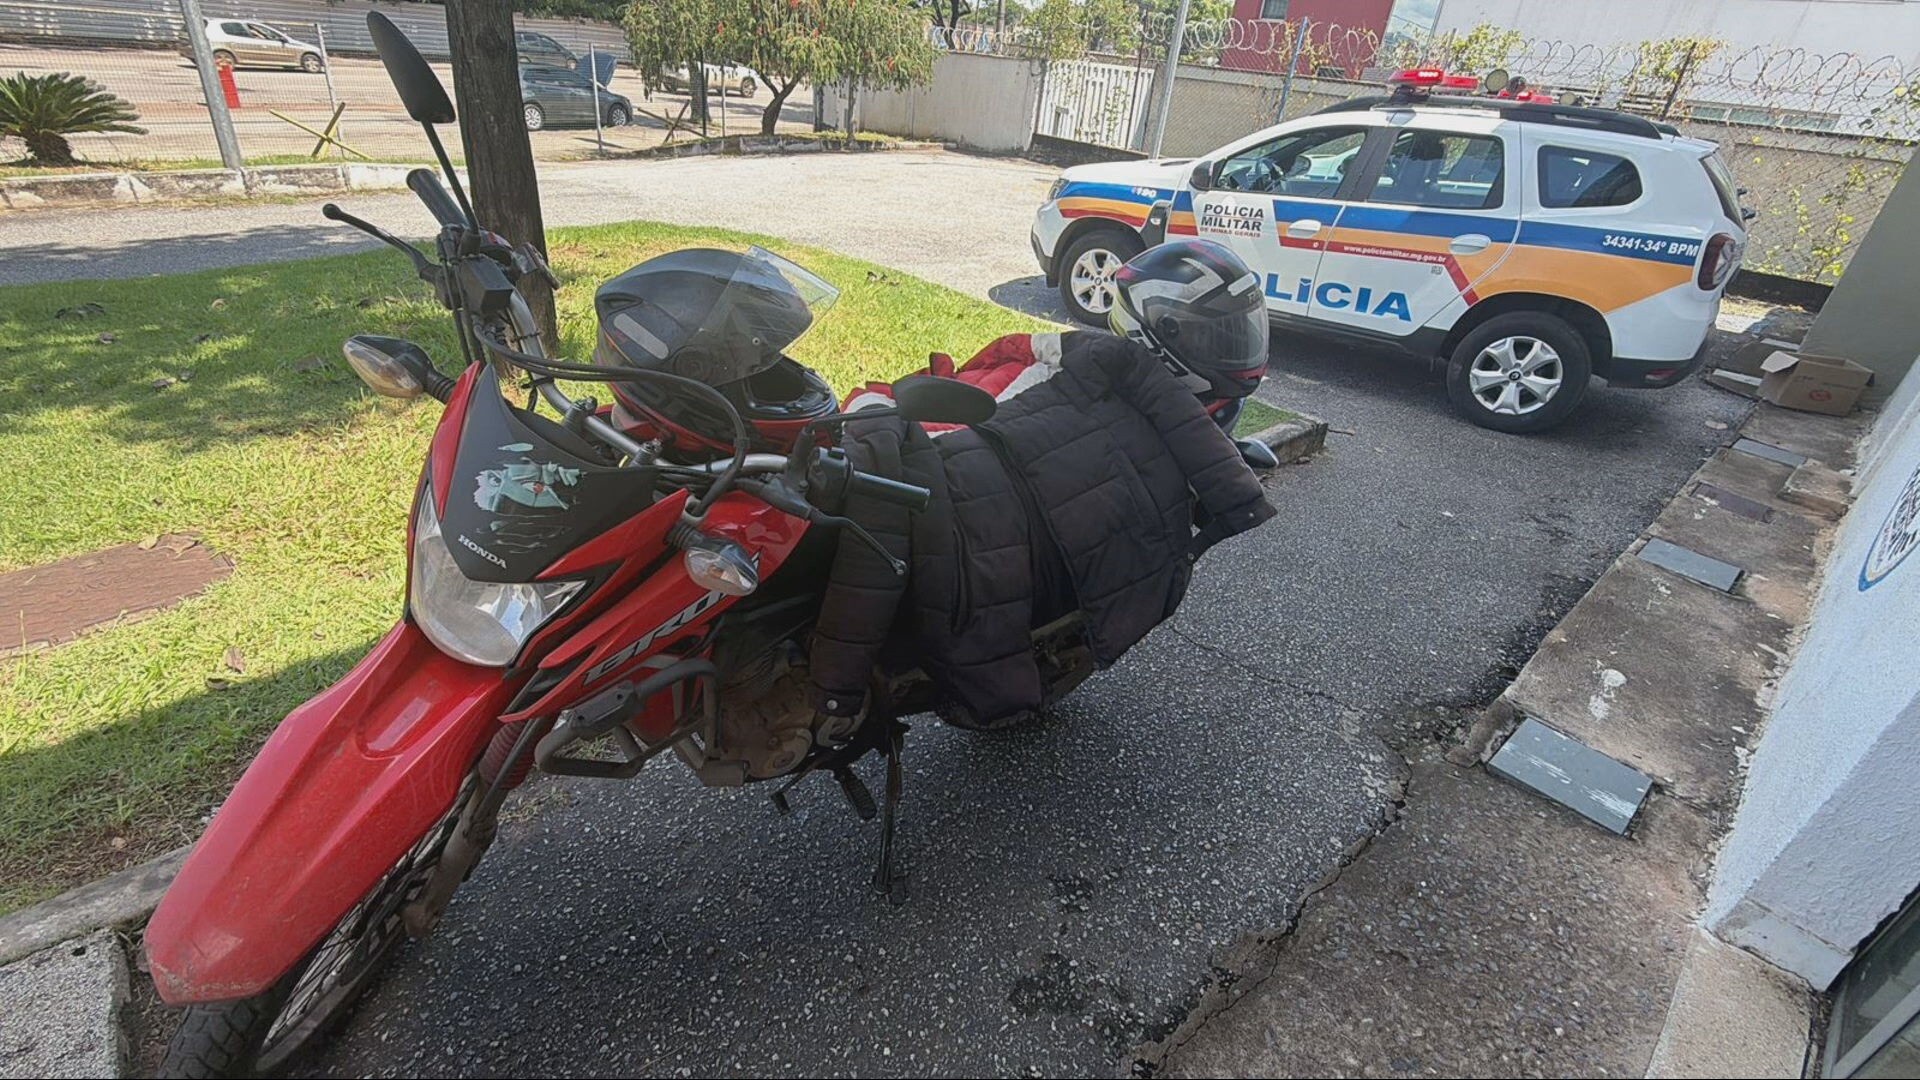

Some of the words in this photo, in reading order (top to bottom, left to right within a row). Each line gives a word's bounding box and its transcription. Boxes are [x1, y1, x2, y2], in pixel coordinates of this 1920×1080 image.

[1201, 216, 1262, 231] MILITAR
[1234, 230, 1261, 238] GERAIS
[1344, 245, 1446, 263] www.policiamilitar.mg.gov.br
[1667, 242, 1700, 257] BPM
[1250, 271, 1412, 322] LÍCIA
[458, 534, 507, 569] HONDA
